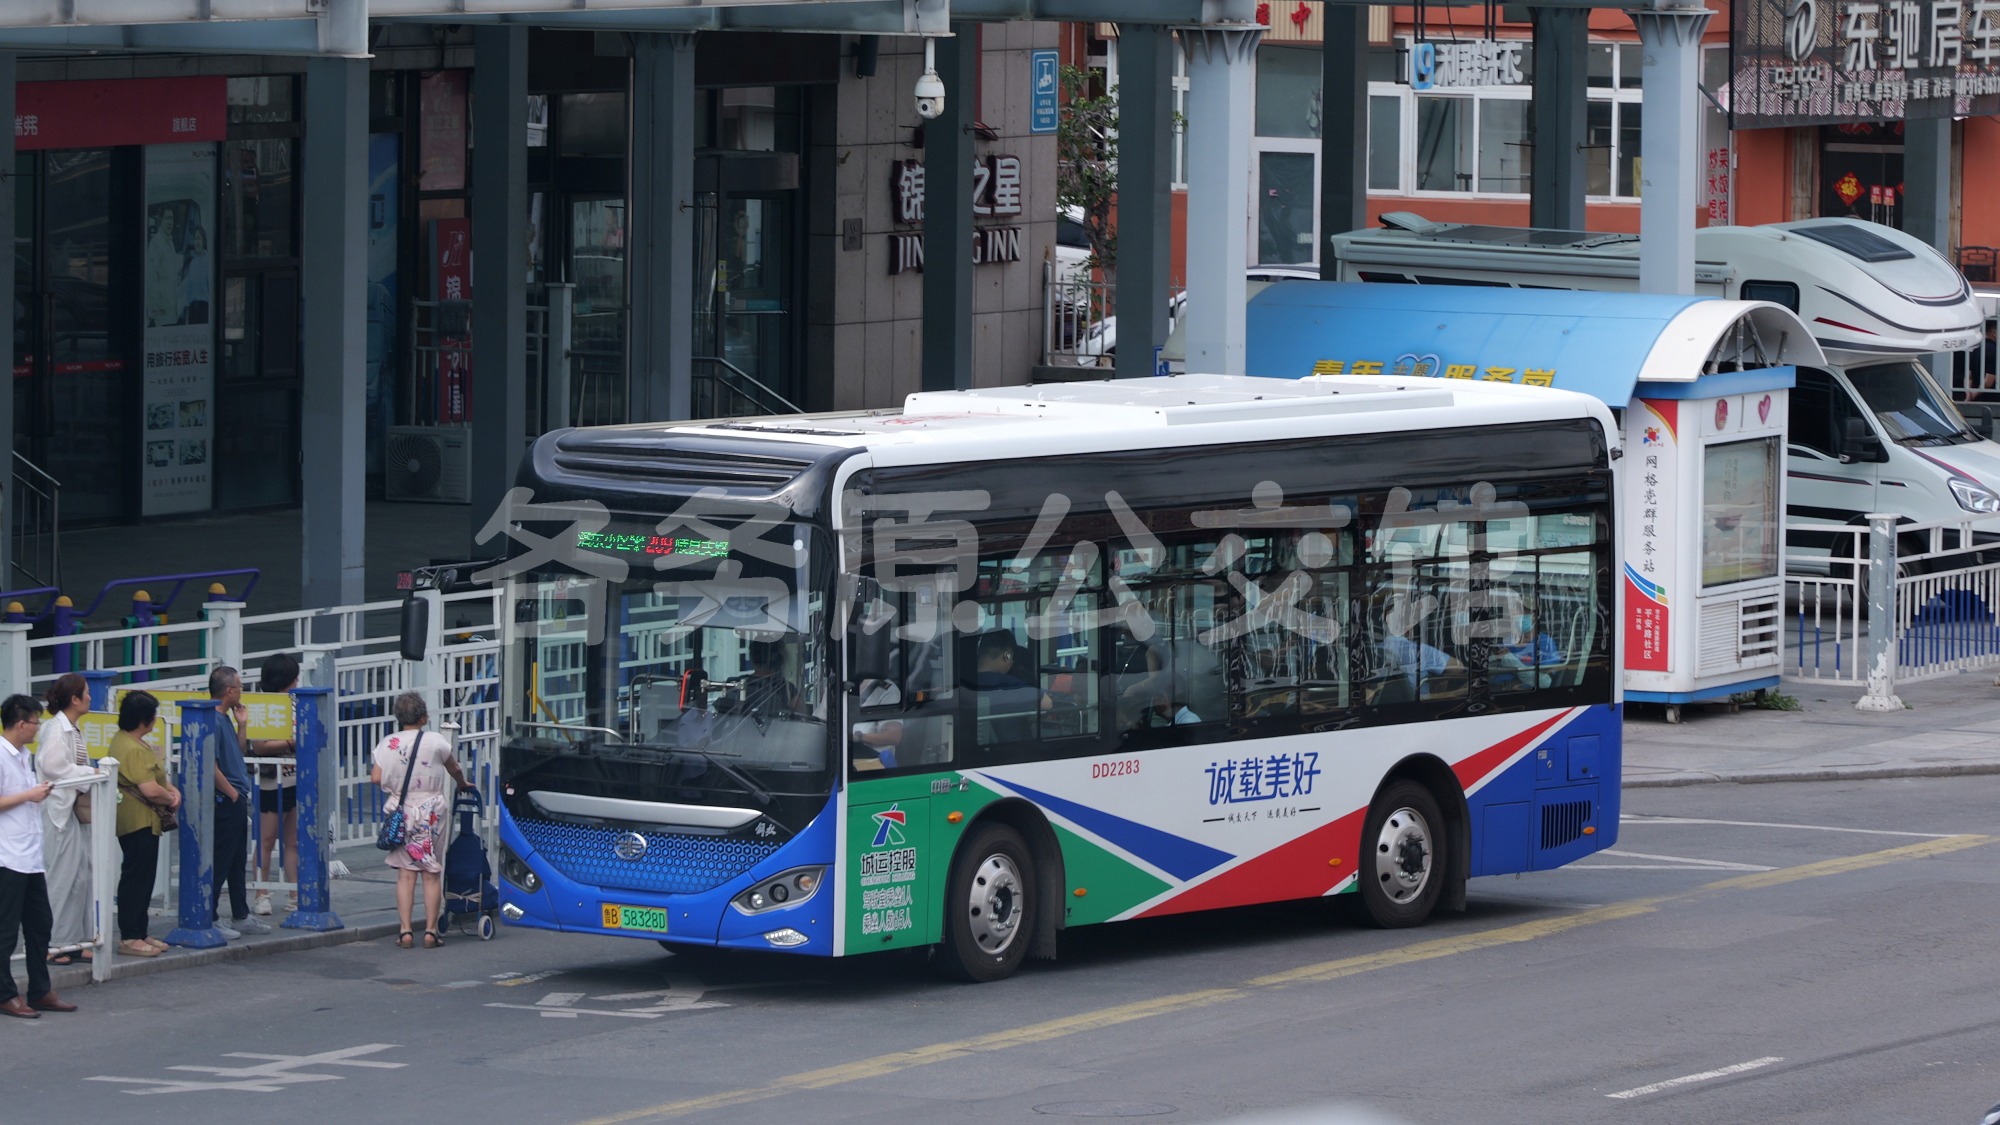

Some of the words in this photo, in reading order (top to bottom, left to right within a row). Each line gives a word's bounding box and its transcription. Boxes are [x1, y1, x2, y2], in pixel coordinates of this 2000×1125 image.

[899, 157, 1022, 221] 锦之星
[987, 229, 1021, 262] INN
[1642, 455, 1657, 573] 网格党群服务站
[1092, 759, 1140, 779] DD2283
[1205, 752, 1321, 805] 诚载美好
[861, 848, 916, 876] 城运控股
